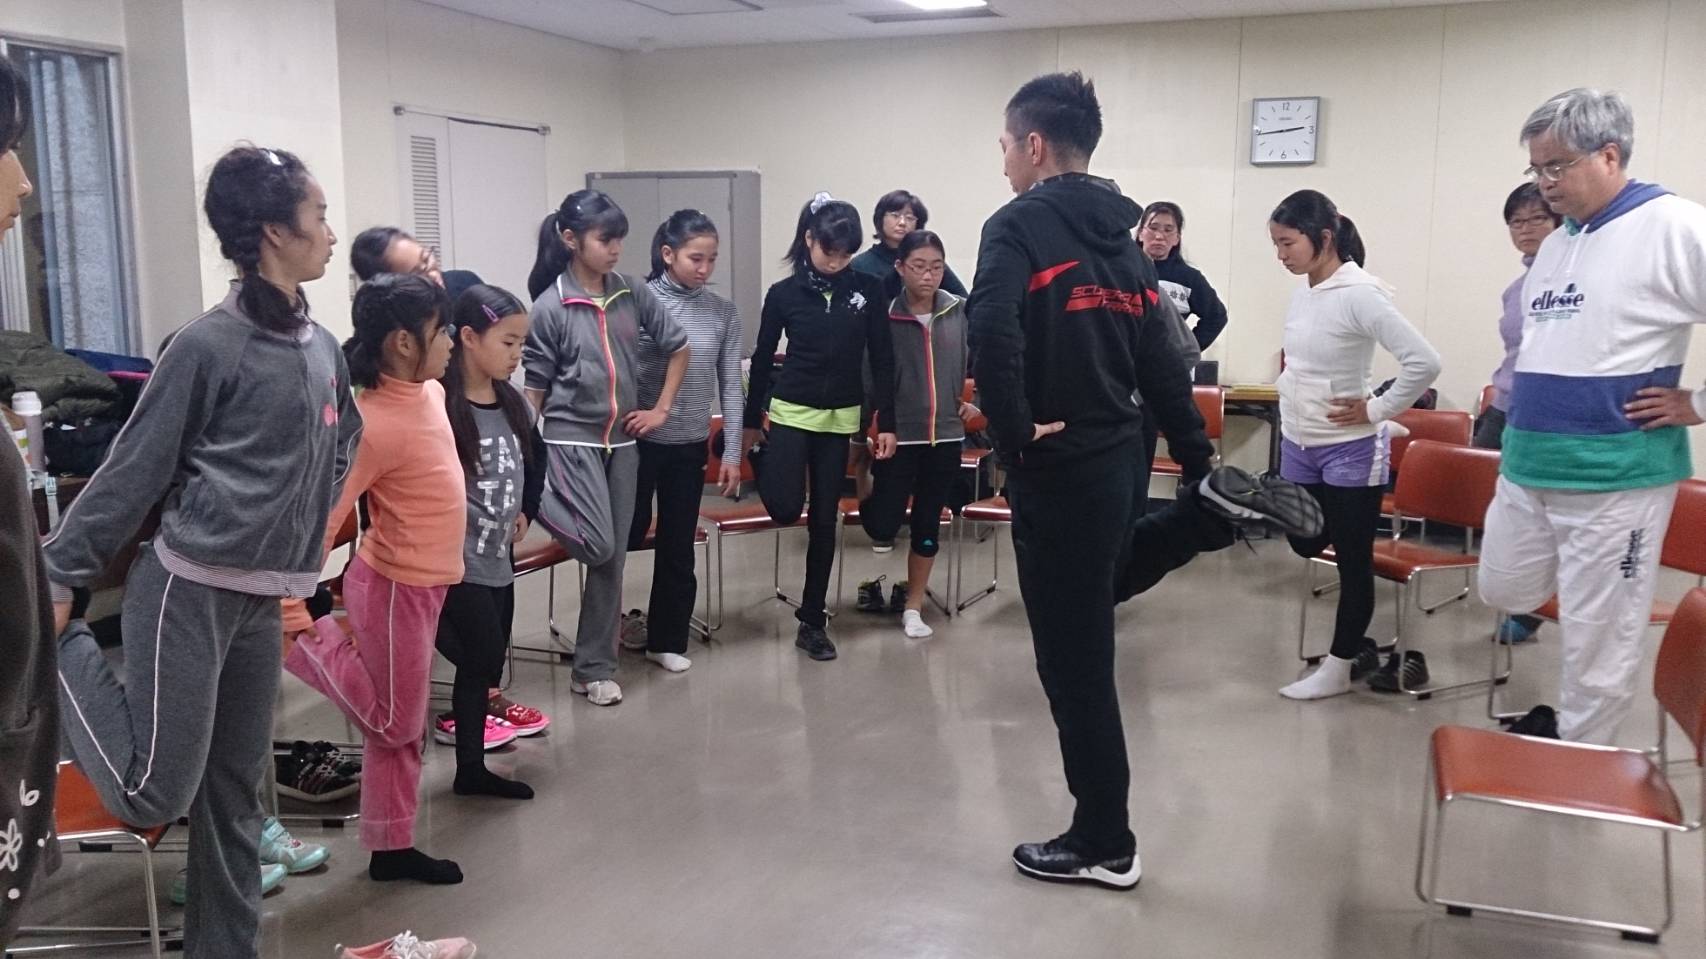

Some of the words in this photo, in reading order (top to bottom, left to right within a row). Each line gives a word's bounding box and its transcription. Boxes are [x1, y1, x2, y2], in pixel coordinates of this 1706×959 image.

[1282, 102, 1290, 112] 12
[1308, 125, 1315, 135] 3
[1280, 150, 1287, 160] 6
[1531, 290, 1585, 310] ellesse
